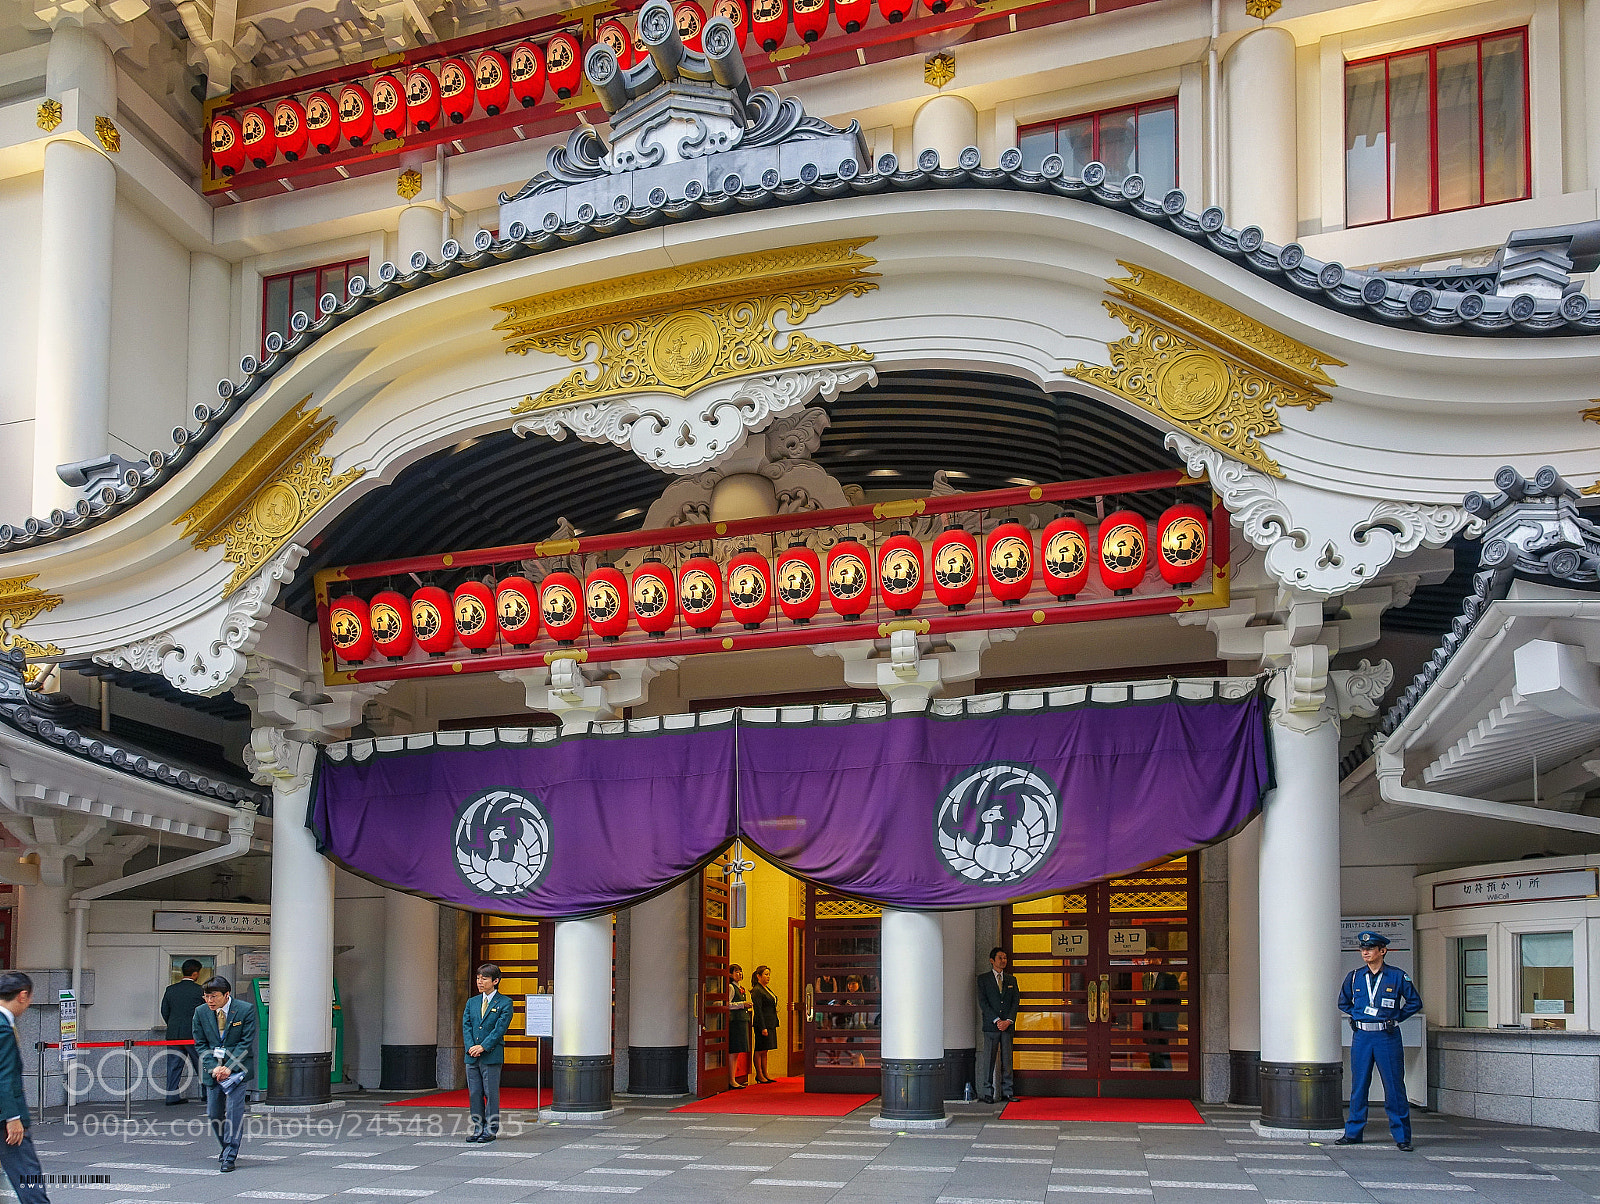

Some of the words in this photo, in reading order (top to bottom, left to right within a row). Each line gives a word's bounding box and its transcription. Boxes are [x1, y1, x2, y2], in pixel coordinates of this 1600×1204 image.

[1463, 877, 1540, 894] 切符預かり所
[1057, 934, 1083, 945] 出口
[1114, 932, 1140, 943] 出口
